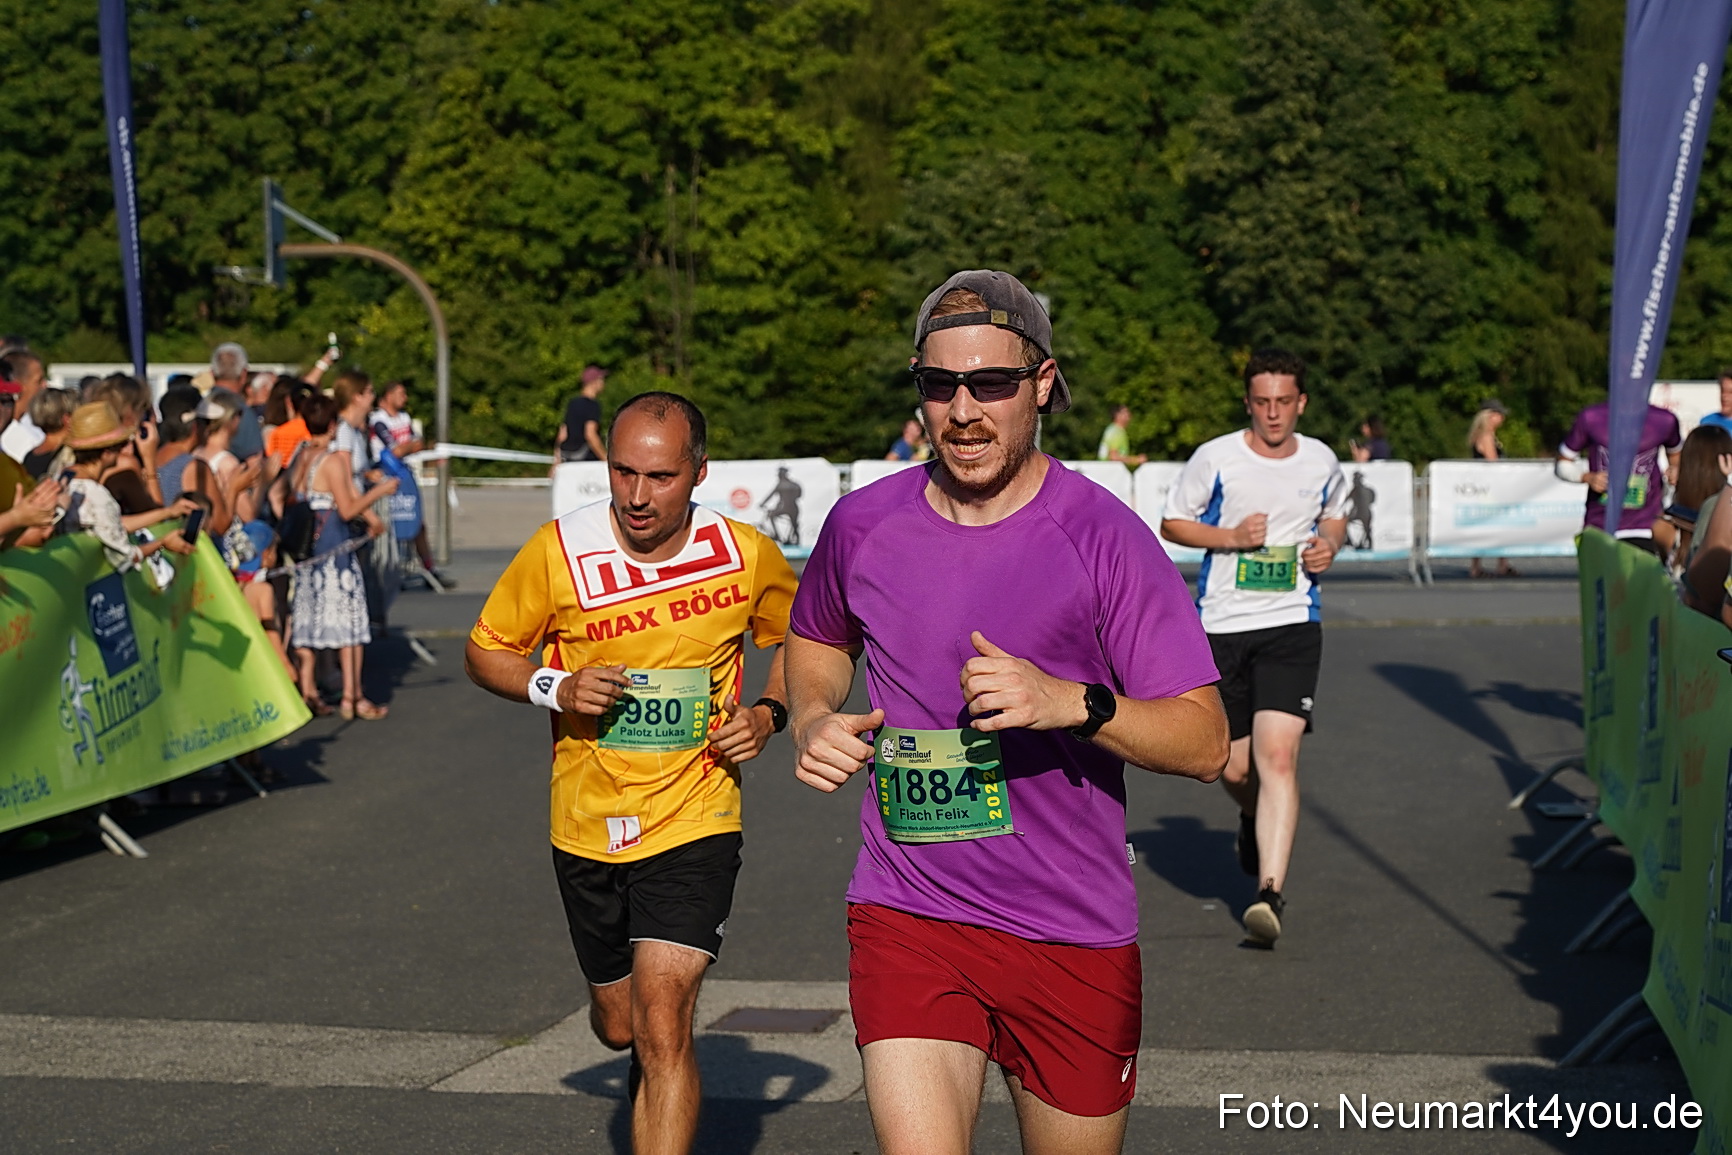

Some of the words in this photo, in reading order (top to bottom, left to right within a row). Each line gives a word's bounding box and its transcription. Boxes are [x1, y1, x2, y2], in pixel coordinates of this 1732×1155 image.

[1630, 62, 1709, 379] www.fischer-automobile.de
[1253, 562, 1287, 577] 313
[586, 607, 660, 641] MAX
[669, 584, 749, 622] BÖGL
[624, 698, 682, 725] 980
[693, 701, 705, 739] 2022
[620, 726, 653, 738] Palotz
[655, 728, 685, 738] Lukas
[895, 749, 932, 759] Firmenlauf
[880, 777, 890, 816] RUN
[889, 767, 981, 805] 1884
[982, 770, 1003, 820] 2022
[899, 808, 932, 821] Flach
[936, 807, 970, 820] Felix
